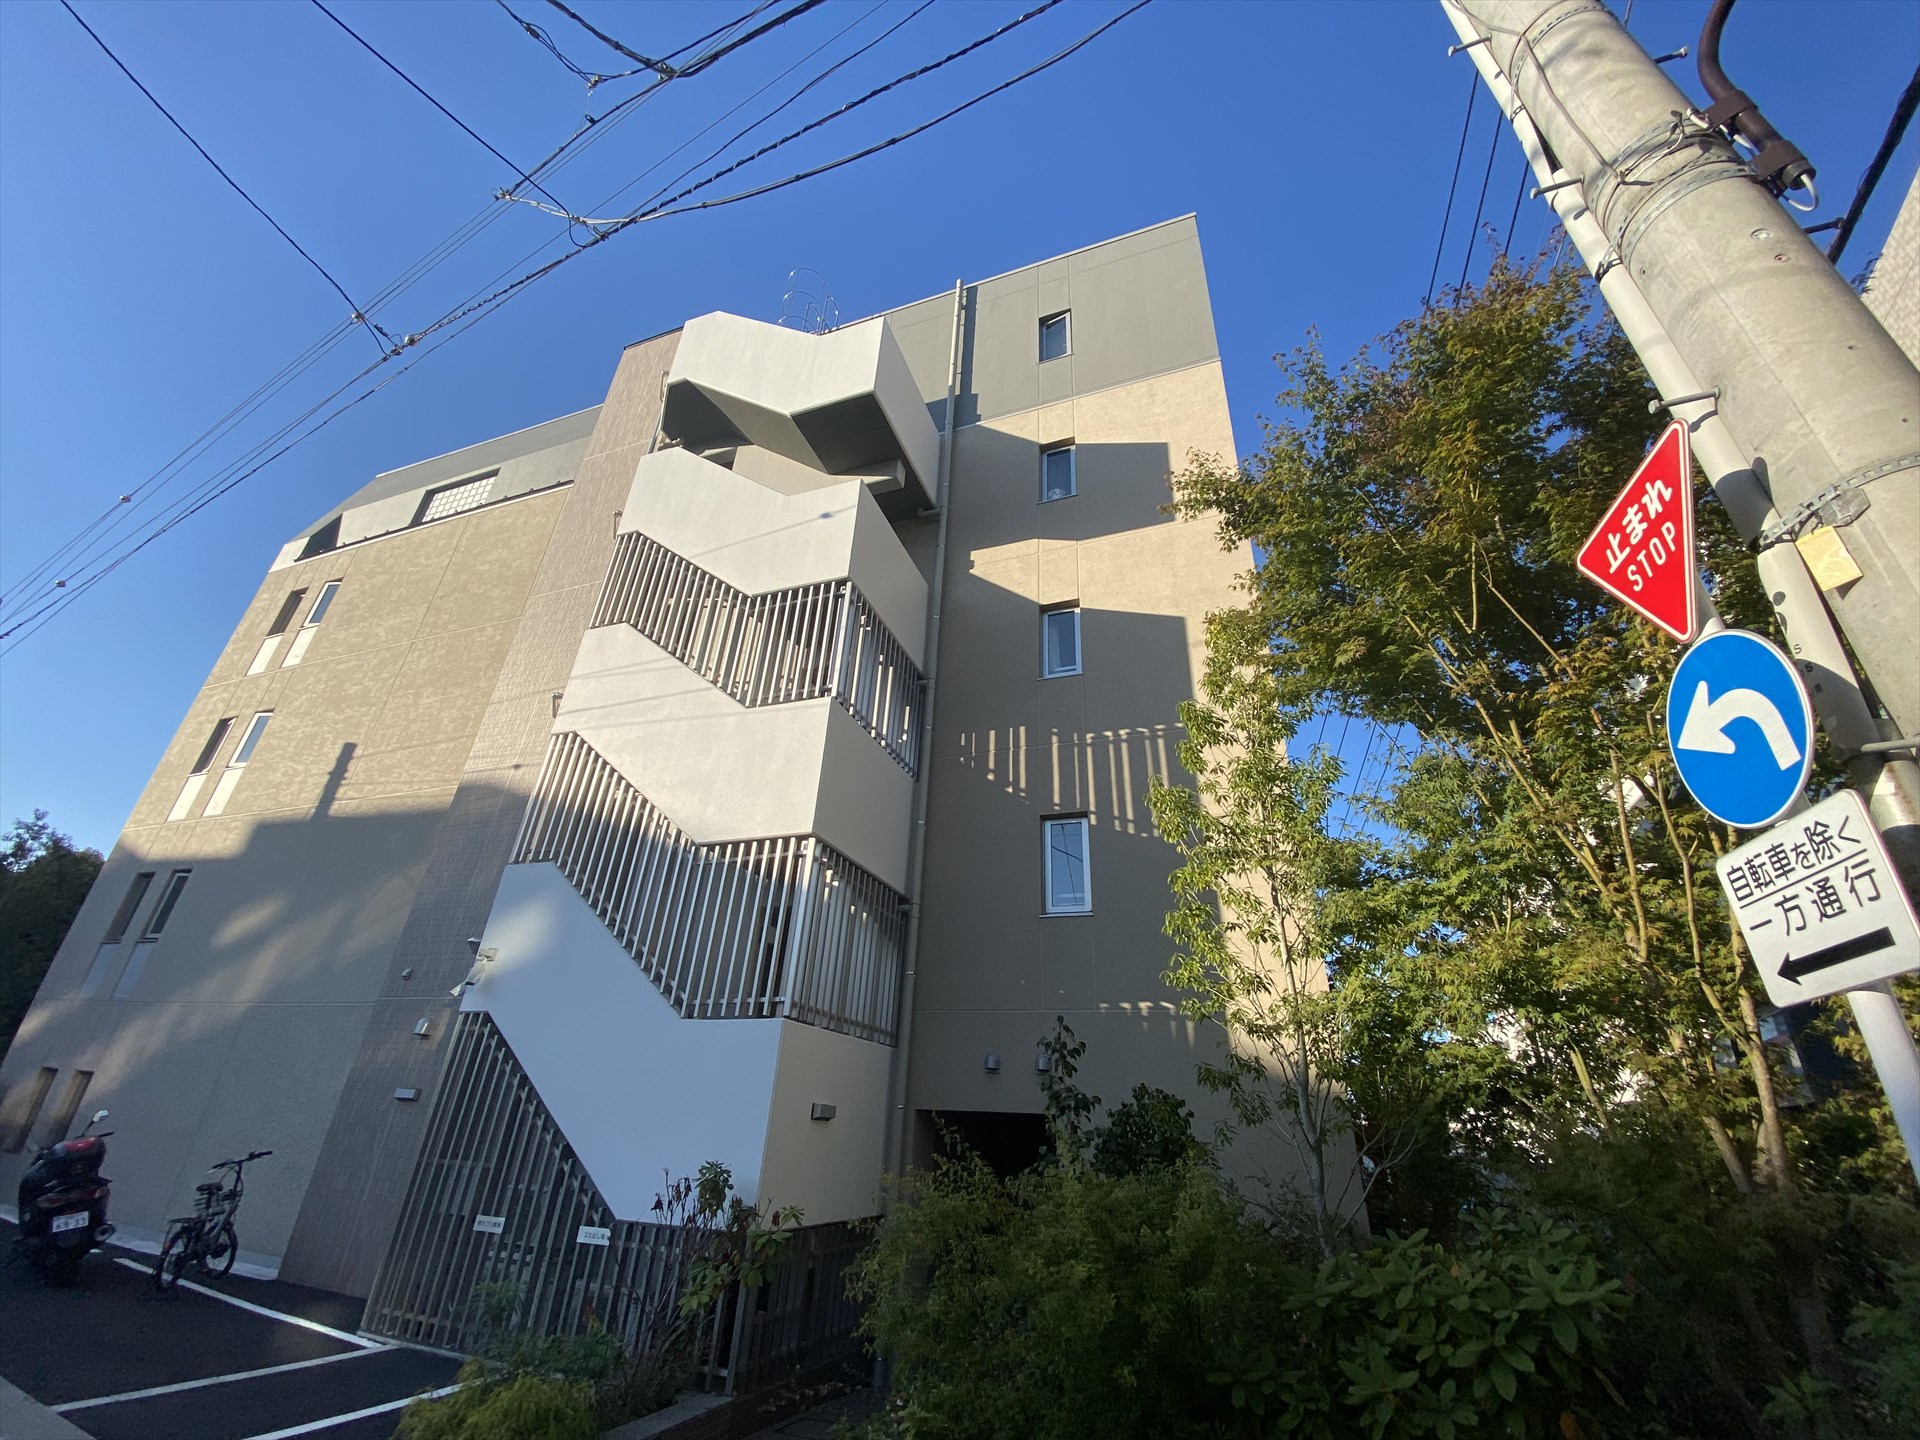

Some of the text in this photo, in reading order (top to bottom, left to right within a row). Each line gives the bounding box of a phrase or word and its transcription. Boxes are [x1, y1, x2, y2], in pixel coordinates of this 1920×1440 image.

[1606, 480, 1672, 573] 止まれ
[1627, 521, 1676, 592] STOP
[1727, 815, 1861, 901] 自転車を除く
[1750, 858, 1881, 936] 一方通行
